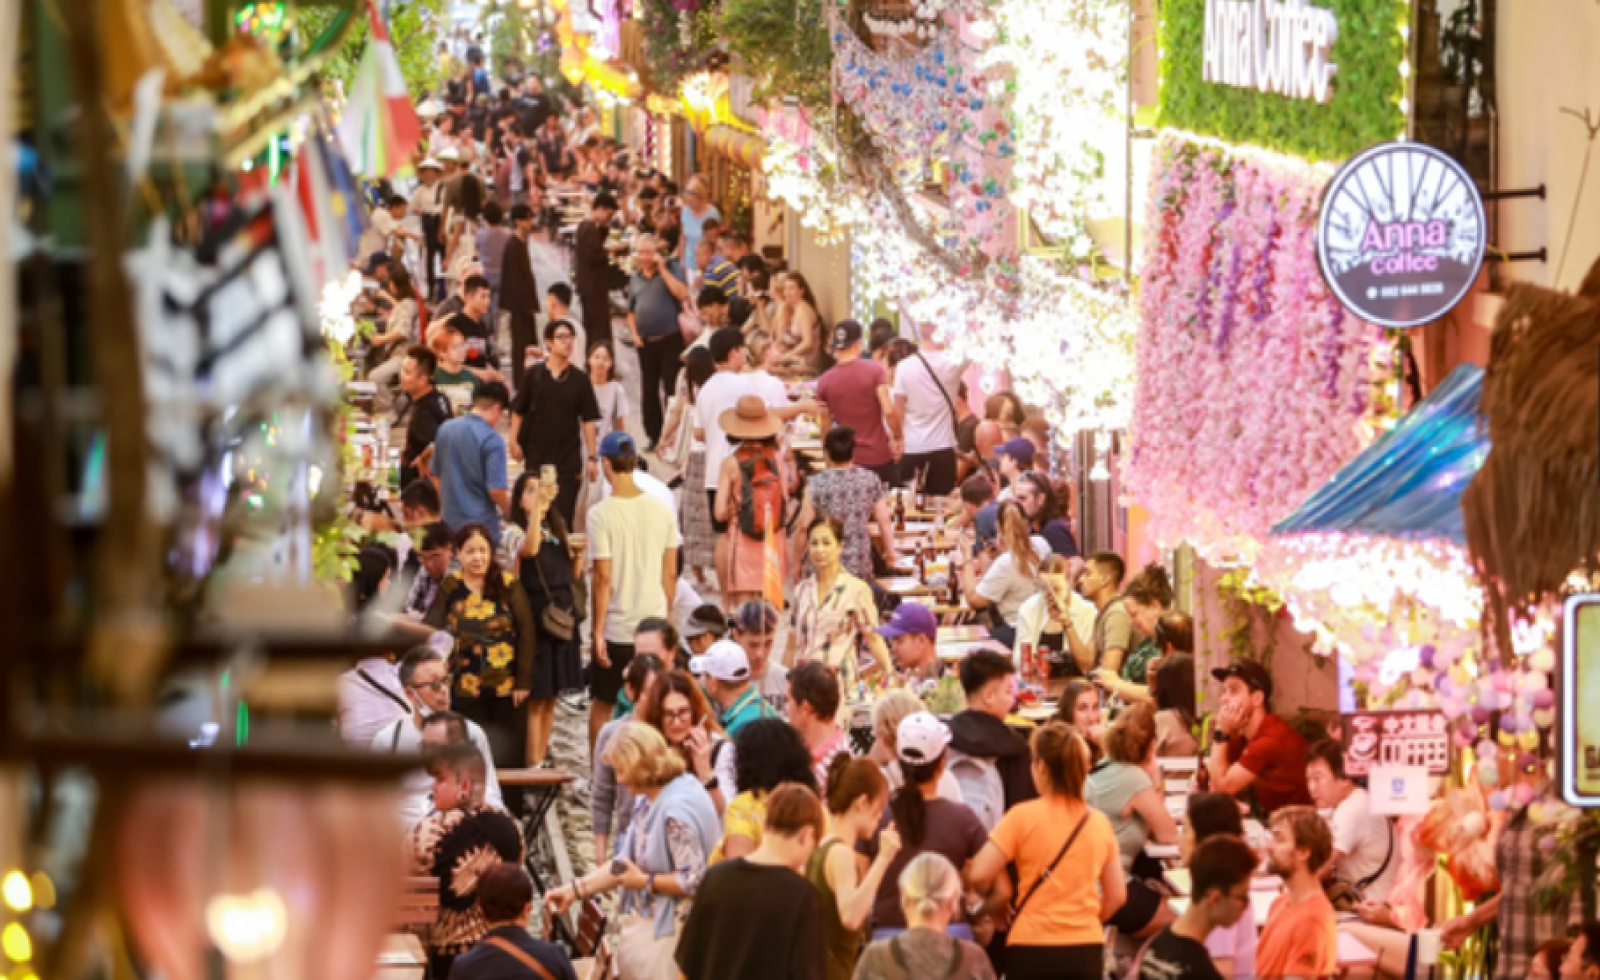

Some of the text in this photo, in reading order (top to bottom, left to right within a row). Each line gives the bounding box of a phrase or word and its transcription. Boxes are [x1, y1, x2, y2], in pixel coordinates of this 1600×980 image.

[1202, 0, 1338, 103] Anna Coffee
[1361, 218, 1446, 251] Anna
[1370, 252, 1438, 275] coffee
